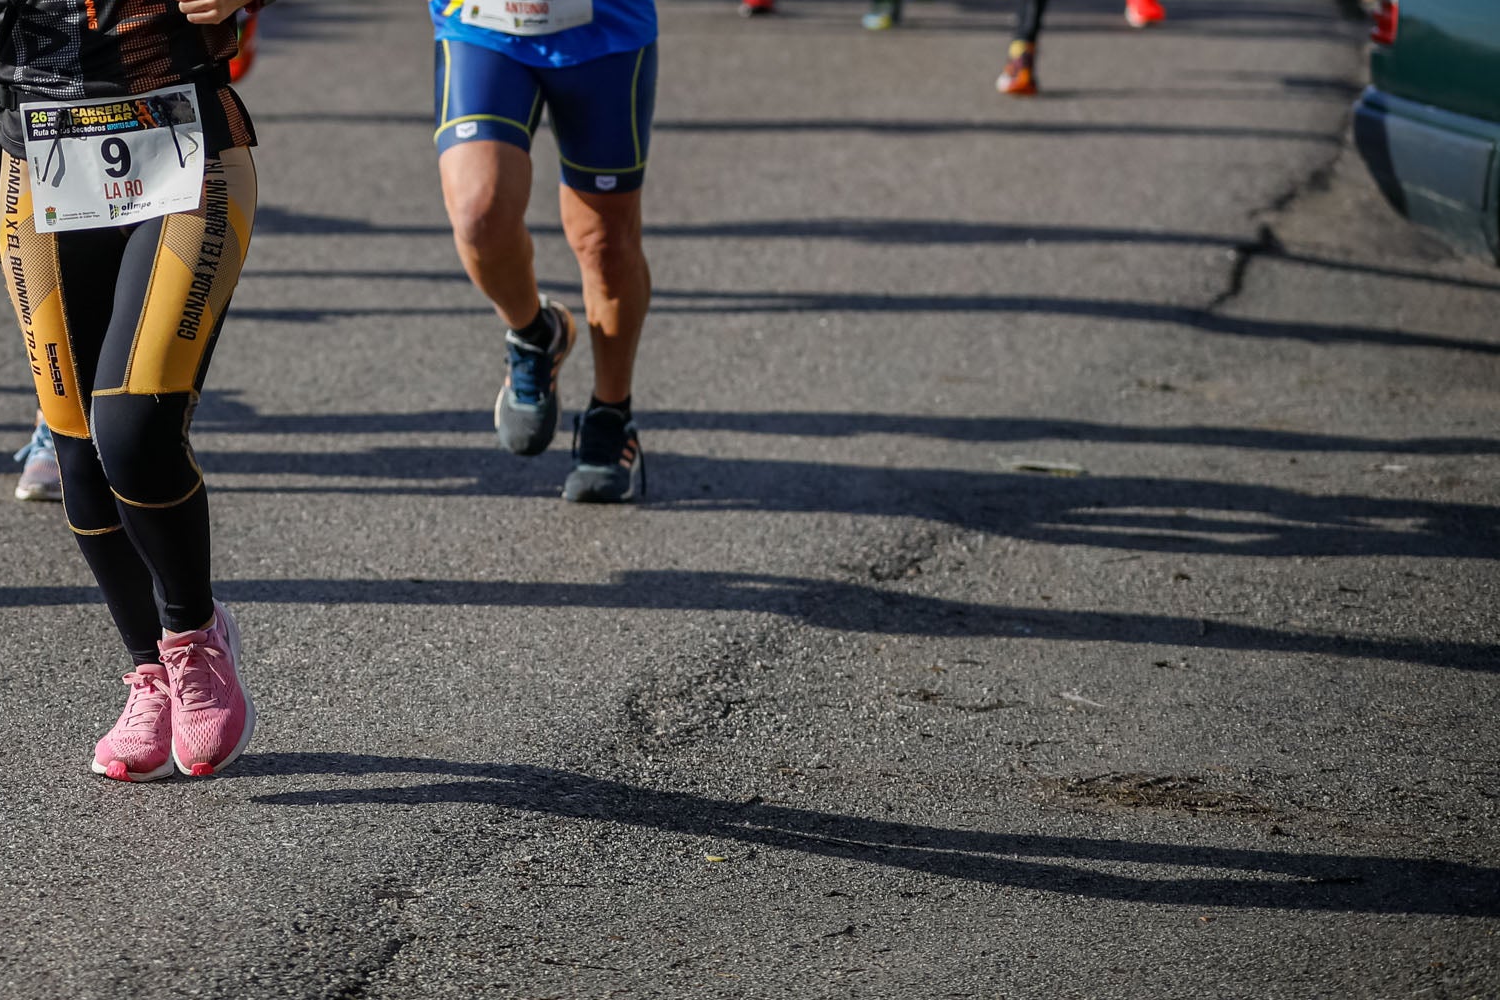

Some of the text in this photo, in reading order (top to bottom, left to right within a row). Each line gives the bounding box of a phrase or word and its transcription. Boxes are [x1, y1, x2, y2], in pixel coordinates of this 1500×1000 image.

[30, 111, 47, 123] 26
[71, 103, 131, 117] CARRERA
[73, 112, 133, 125] POPULAR
[33, 129, 49, 137] Ruta
[71, 125, 106, 133] Secaderos
[101, 137, 131, 178] 9
[6, 156, 21, 214] RANADA
[104, 179, 143, 199] LA RO
[122, 201, 152, 211] olimpo
[204, 179, 228, 241] RUNNING
[6, 218, 18, 229] X
[6, 232, 19, 251] EL
[201, 240, 224, 261] EL
[198, 258, 217, 272] X
[9, 255, 33, 326] RUNNING
[177, 271, 215, 341] GRANADA
